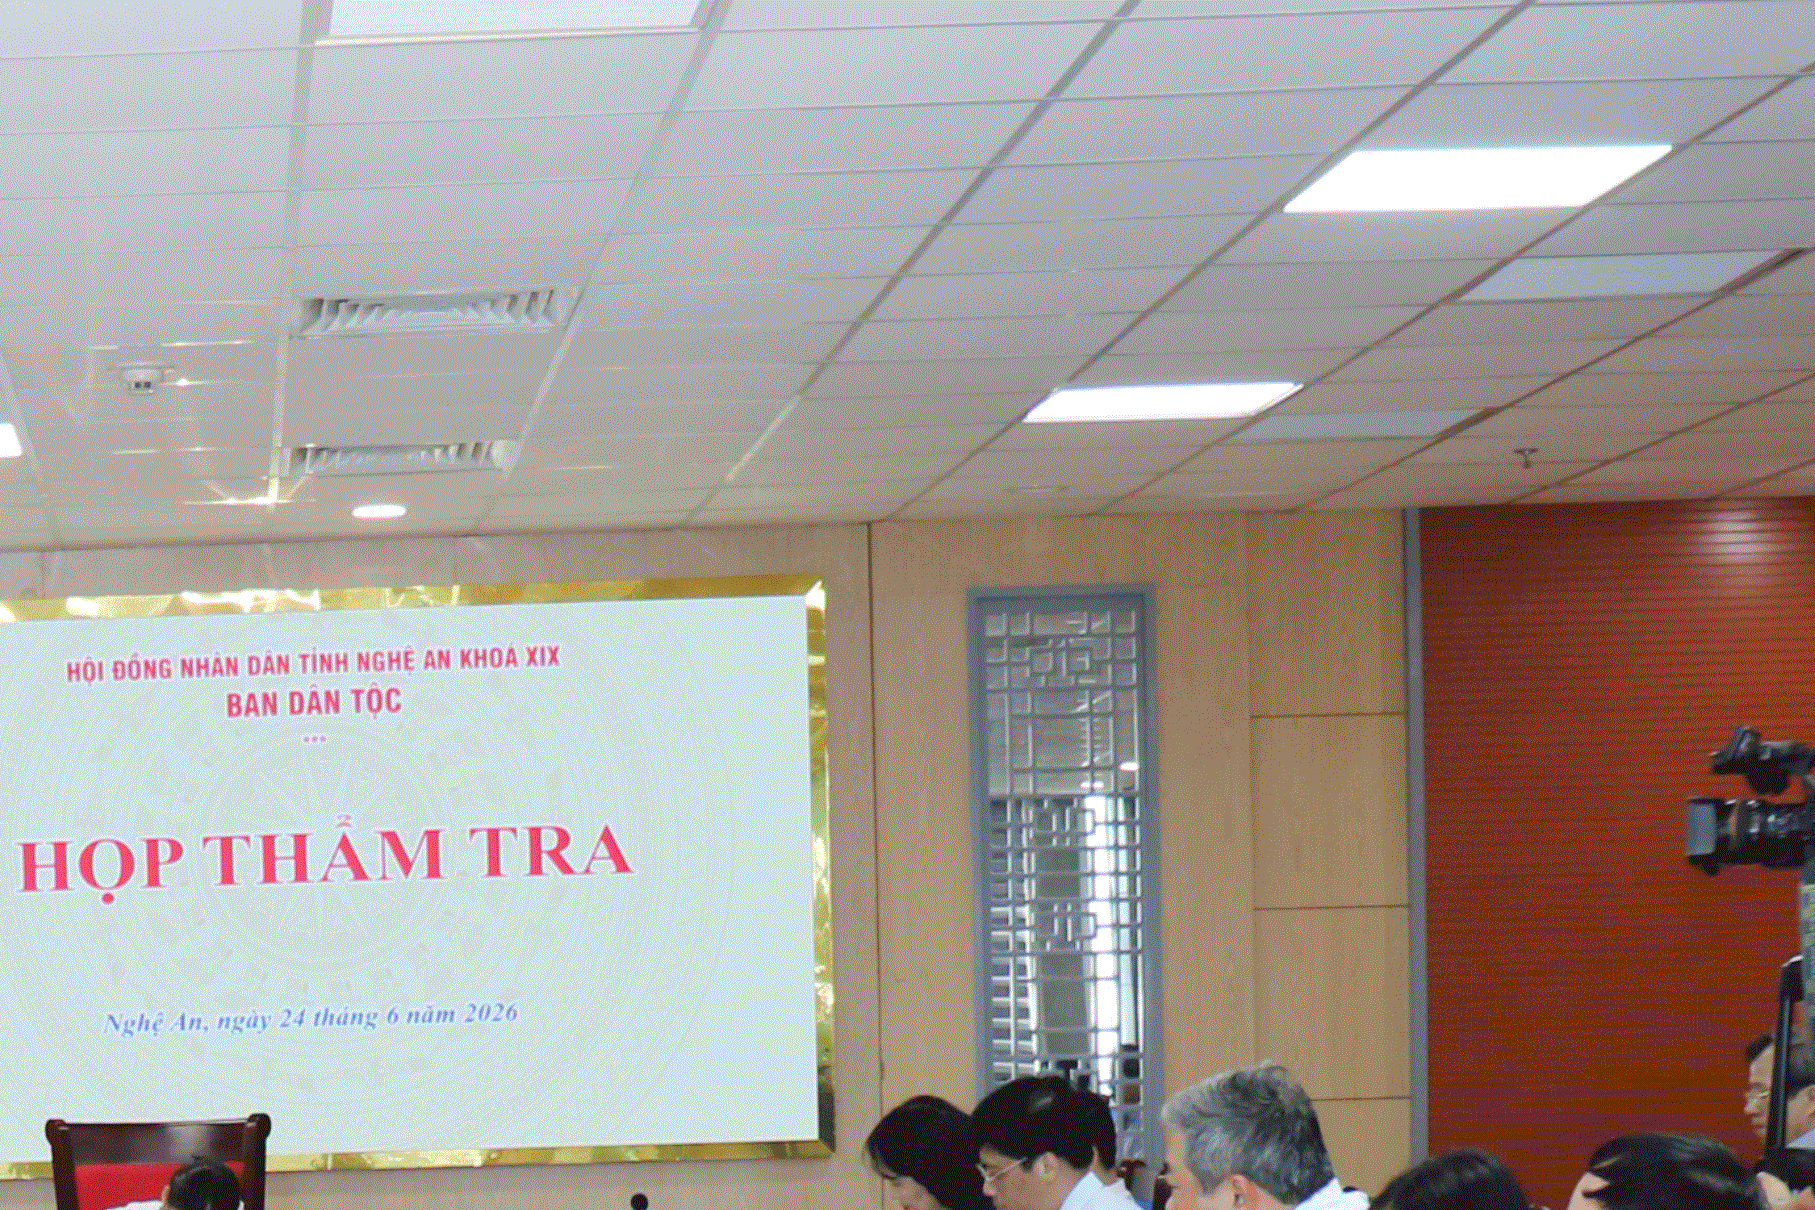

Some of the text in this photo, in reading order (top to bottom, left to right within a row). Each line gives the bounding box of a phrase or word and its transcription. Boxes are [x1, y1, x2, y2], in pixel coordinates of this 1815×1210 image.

[66, 642, 561, 686] HỘI ĐỒNG NHÂN DÂN TỈNH NGHỆ AN KHOÁ XIX
[226, 681, 403, 719] BAN DÂN TỘC
[18, 813, 635, 905] HỌP THẨM TRA
[102, 1002, 519, 1039] Nghệ An, ngày 24 tháng 6 năm 2026
